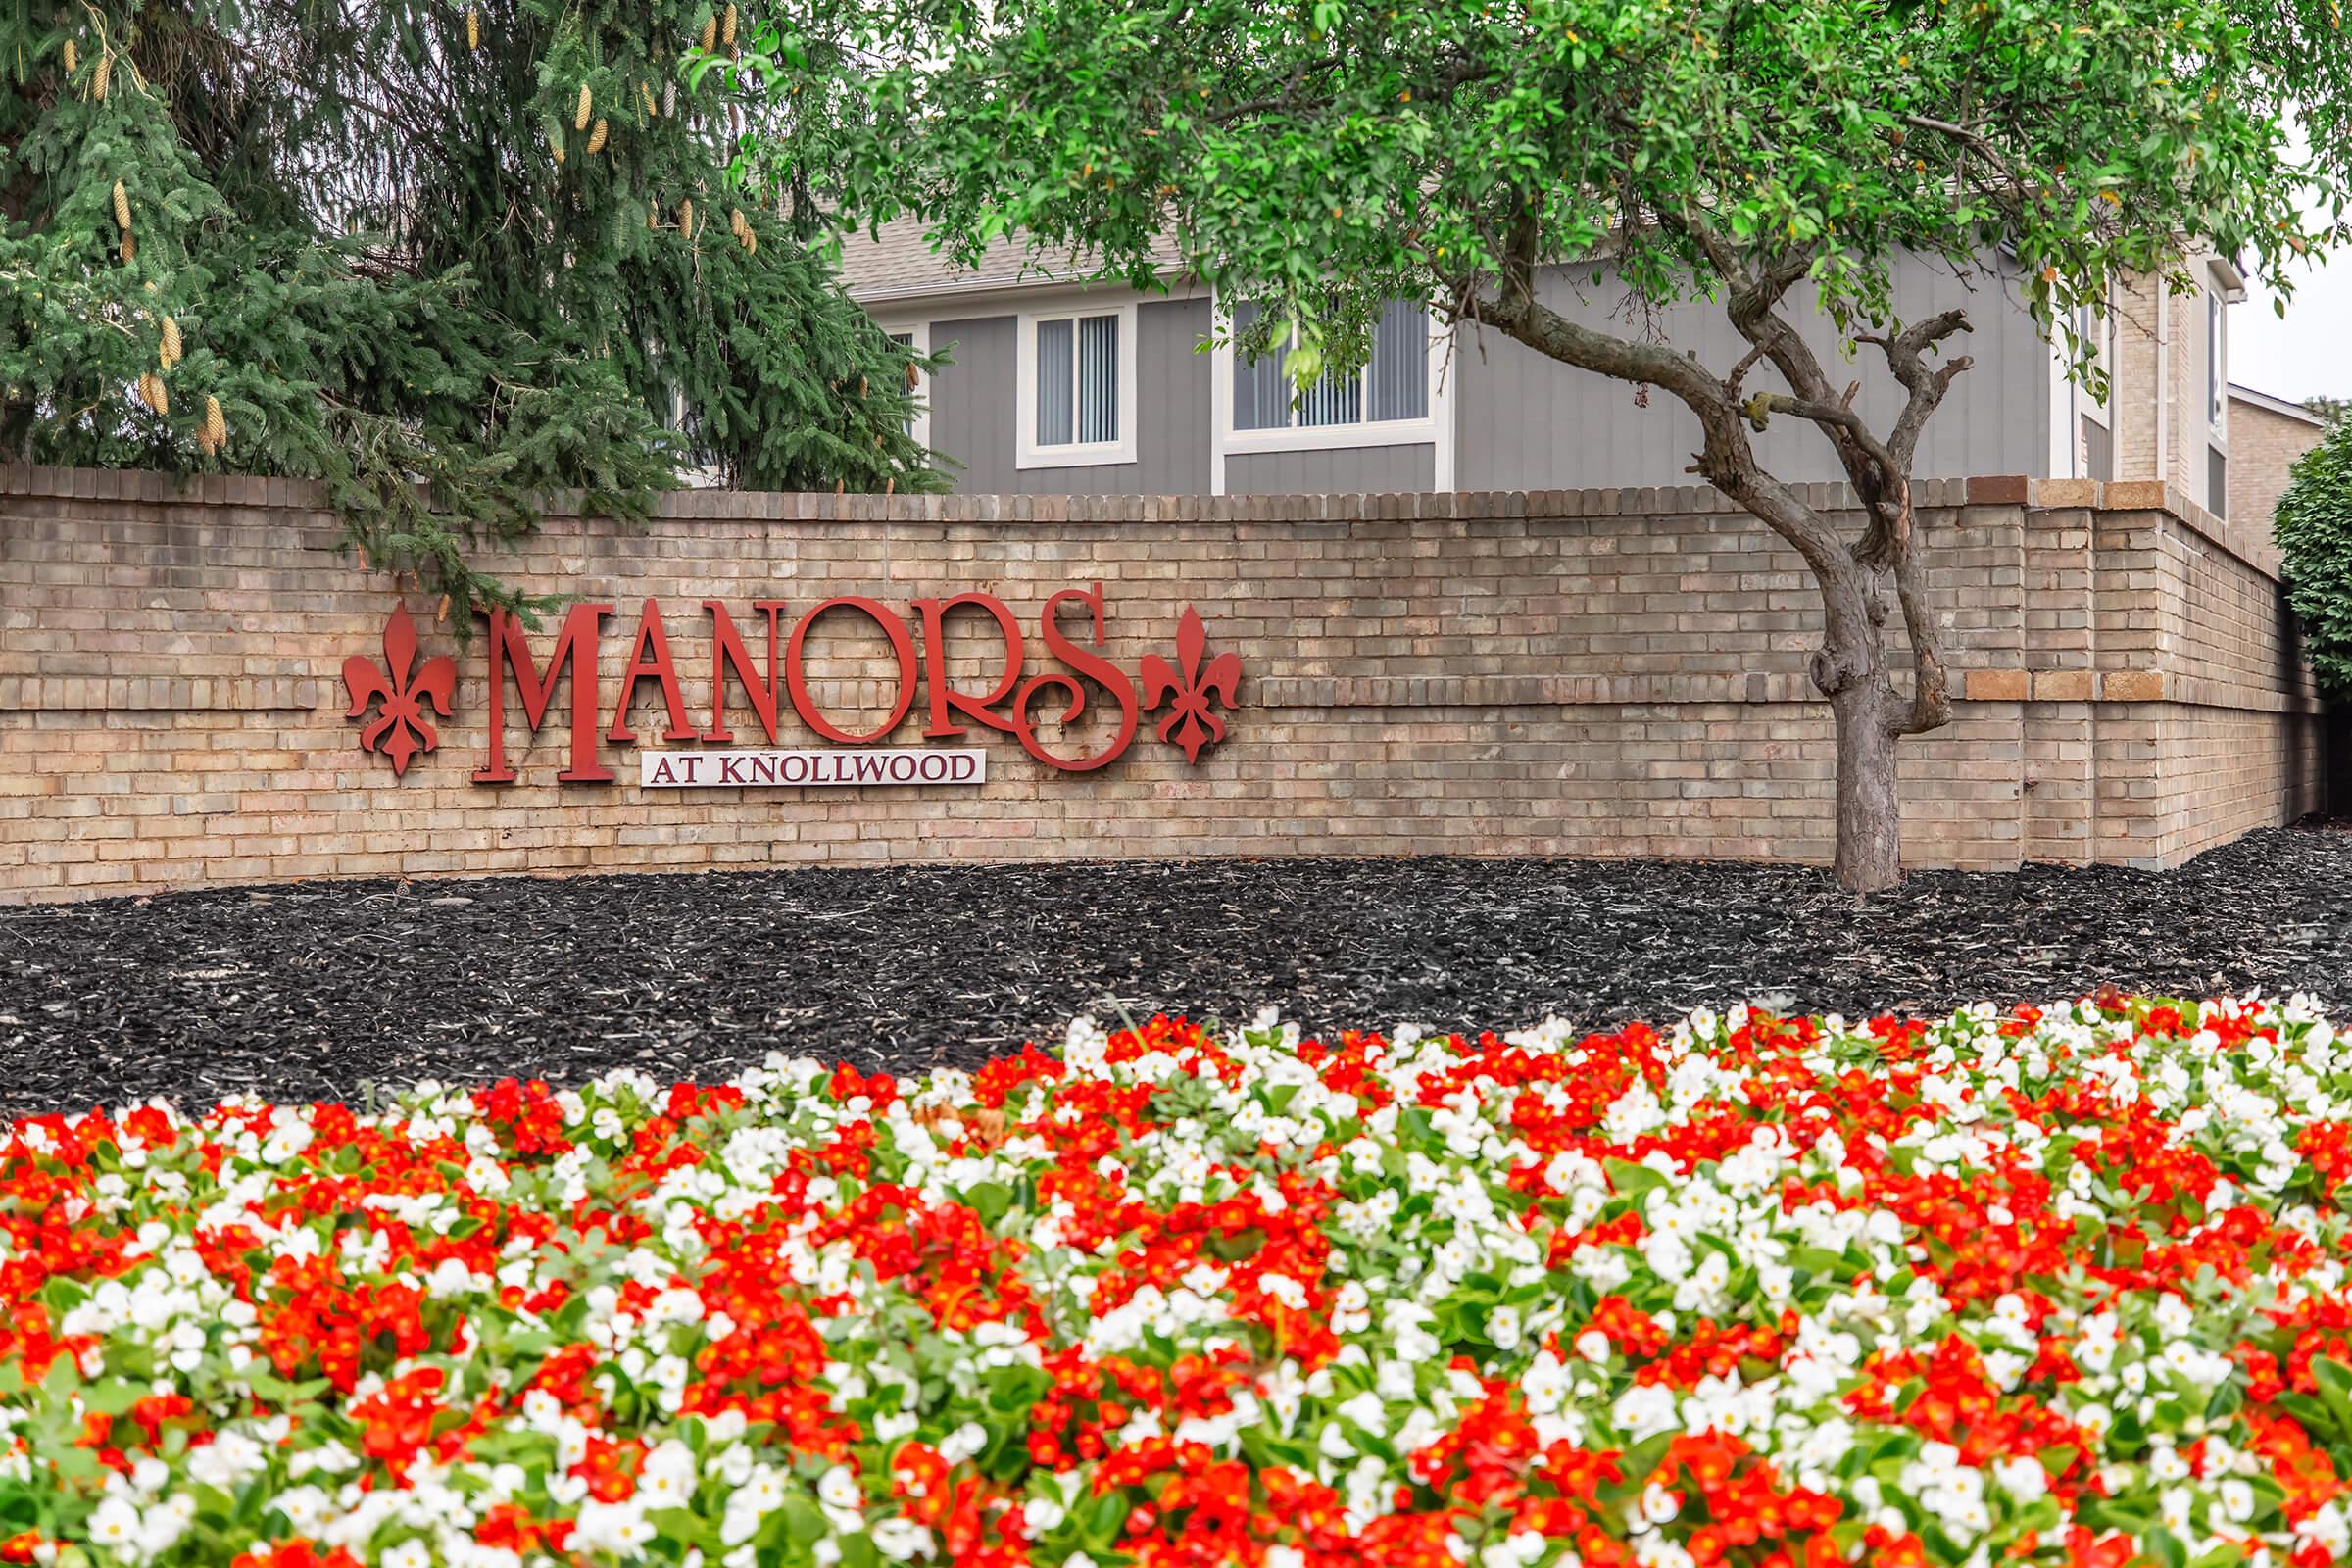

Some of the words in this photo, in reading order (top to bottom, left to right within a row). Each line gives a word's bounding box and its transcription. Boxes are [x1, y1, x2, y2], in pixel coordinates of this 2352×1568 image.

[472, 581, 1138, 784] MANORS
[650, 756, 704, 784] AT
[718, 754, 977, 784] KNOLLWOOD
